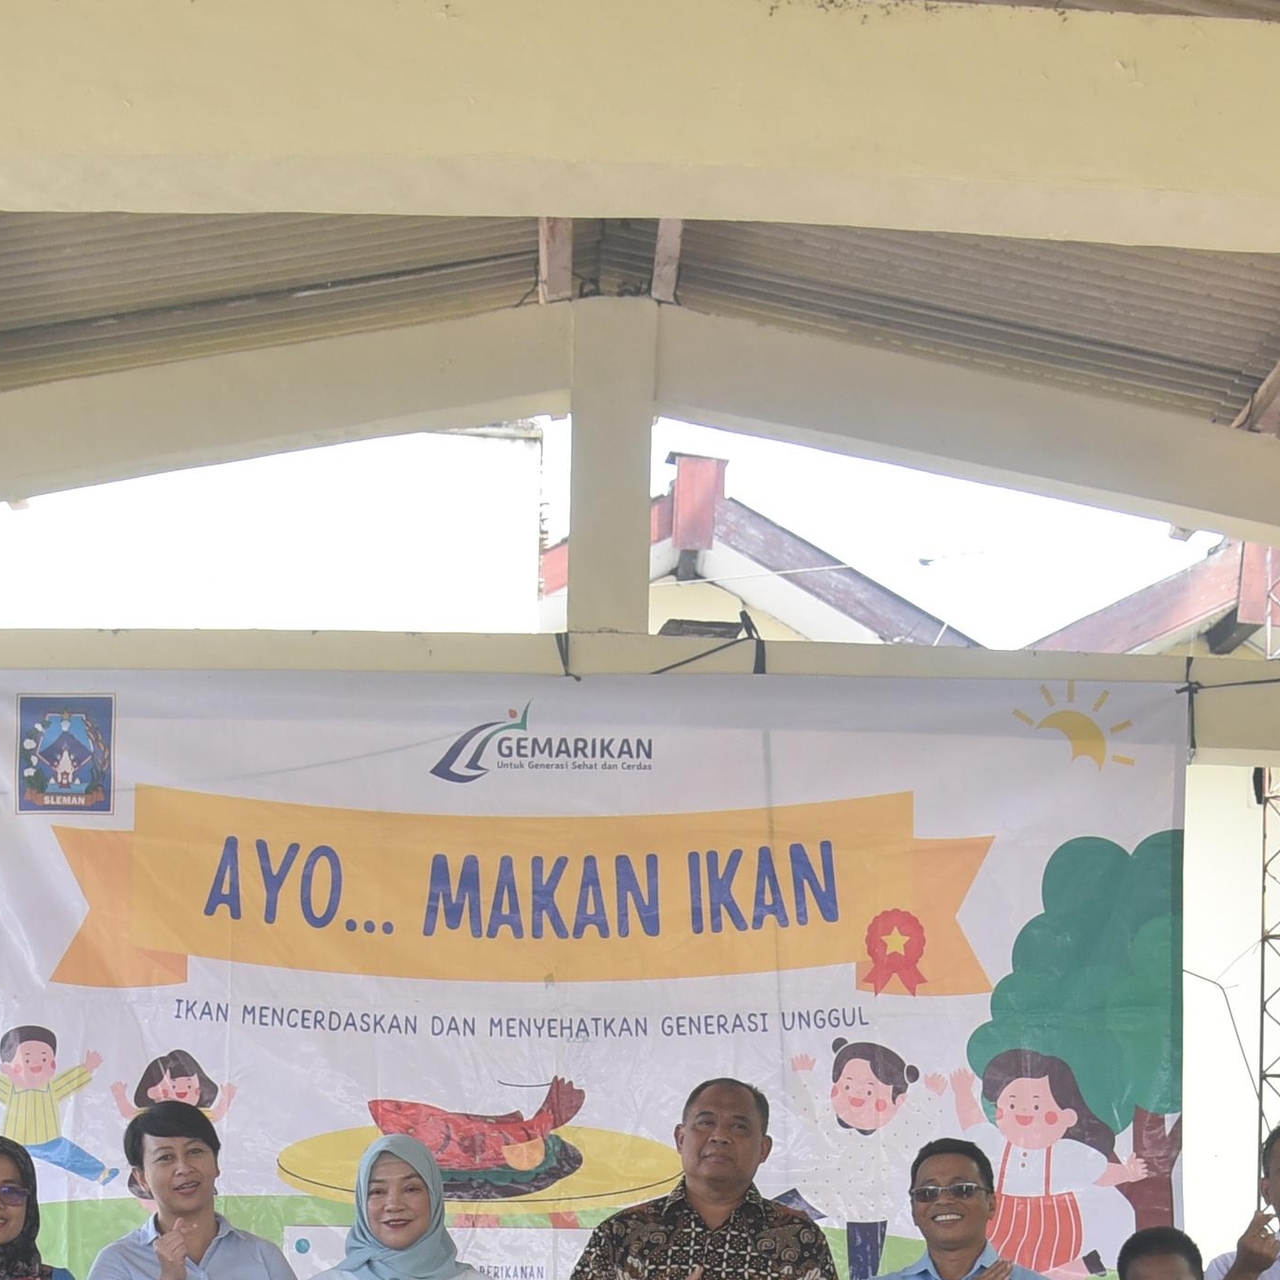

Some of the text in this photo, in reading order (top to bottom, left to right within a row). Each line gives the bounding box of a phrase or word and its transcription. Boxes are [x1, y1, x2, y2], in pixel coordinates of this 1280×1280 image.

[497, 737, 653, 759] GEMARIKAN
[497, 760, 653, 771] Untuk Generasi Sehat dan Cerdas
[43, 795, 86, 805] SLEMAN
[204, 836, 840, 939] AYO... MAKAN IKAN
[175, 999, 870, 1039] IKAN MENCERDASKAN DAN MENYEHATKAN GENERASI UNGGUL
